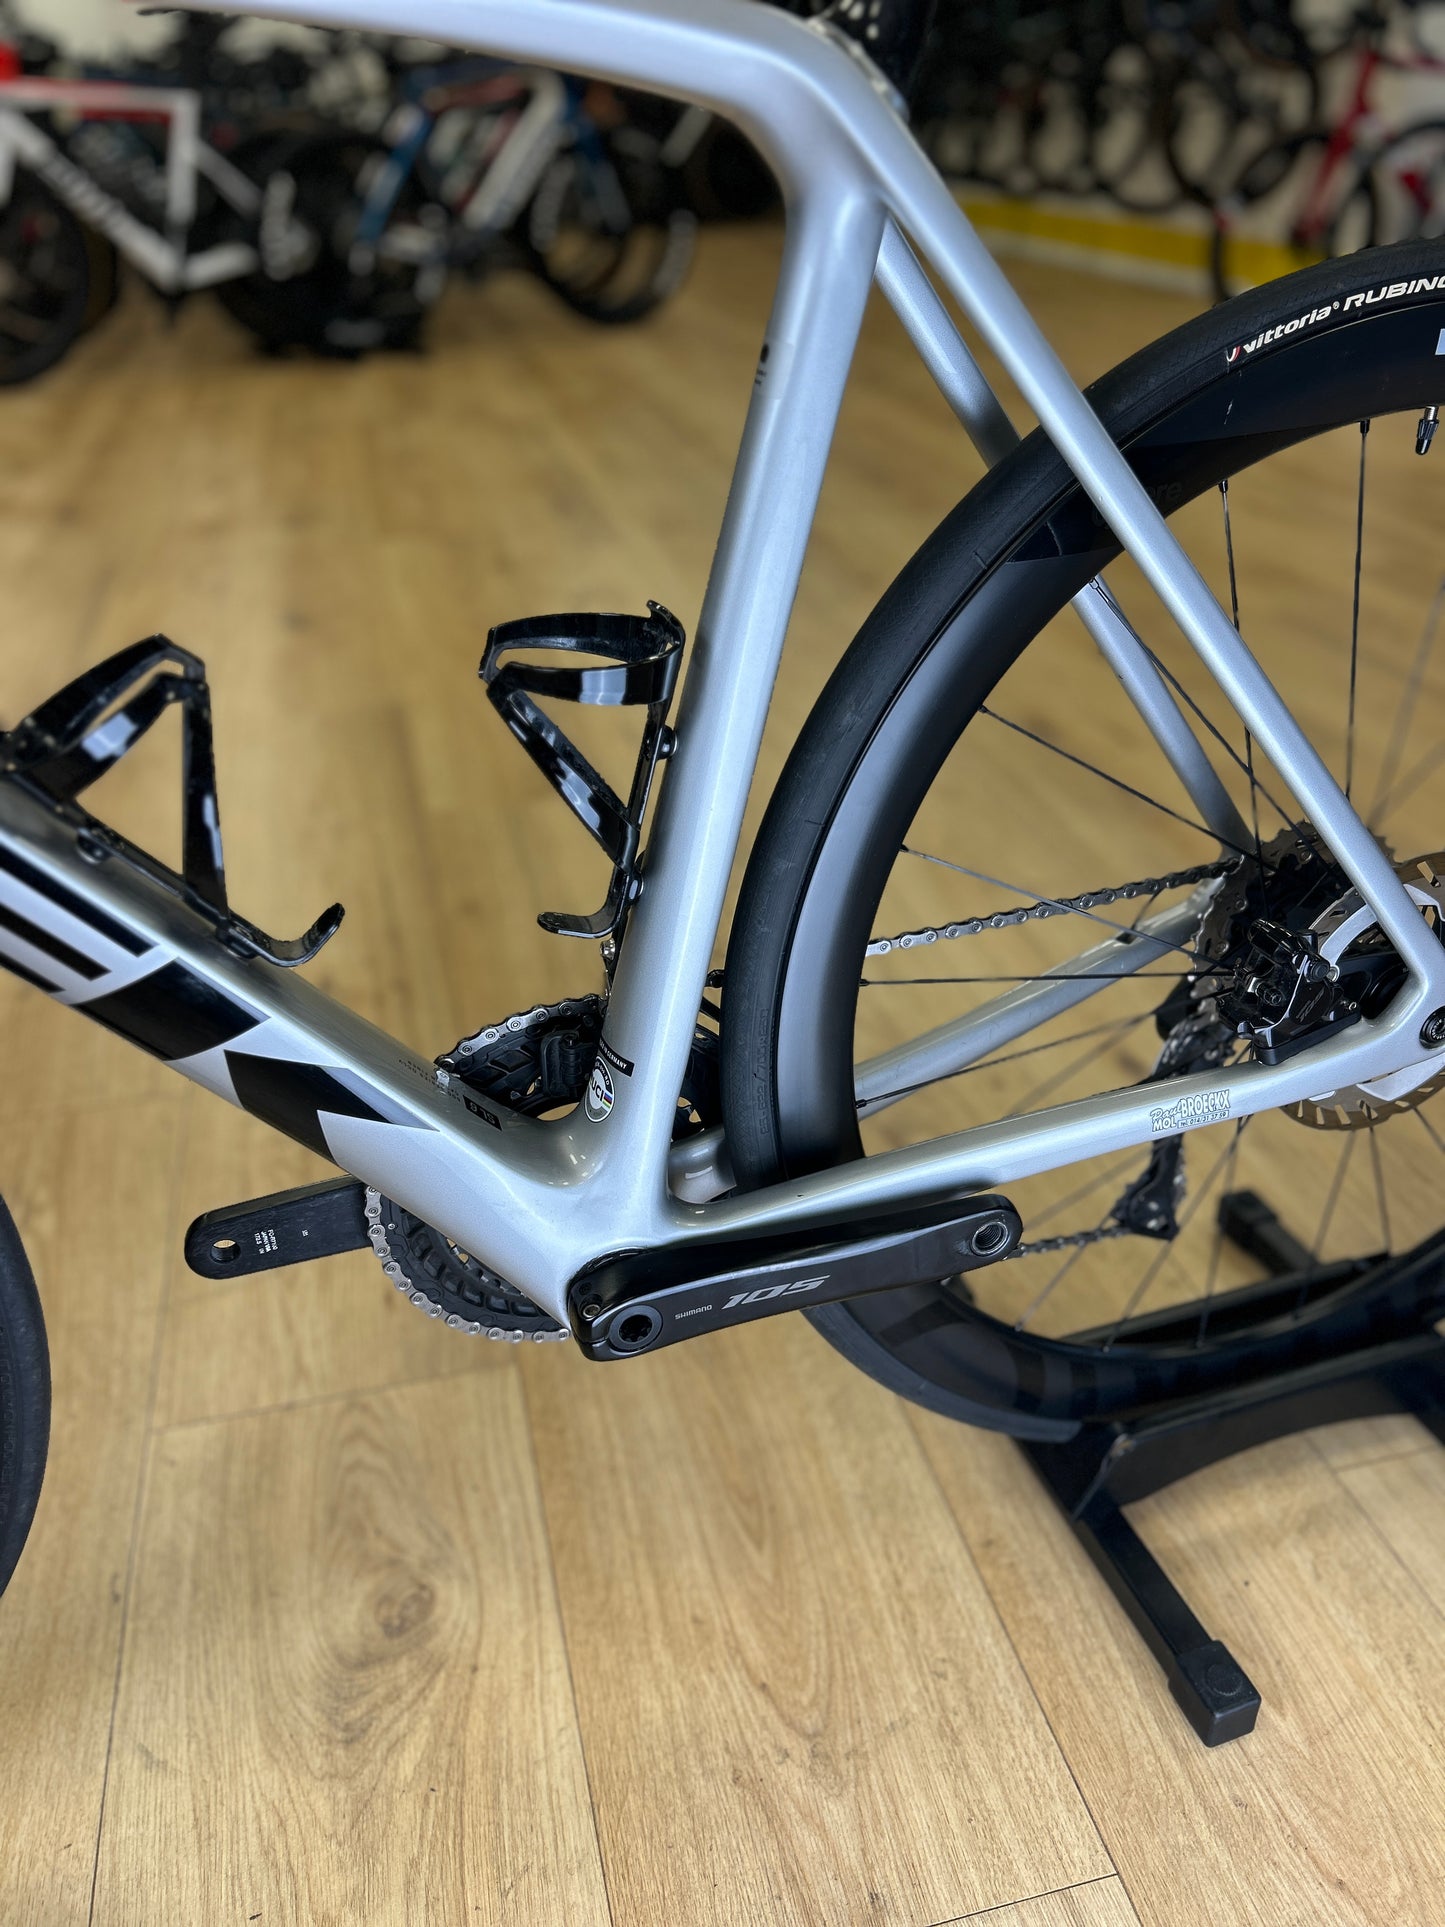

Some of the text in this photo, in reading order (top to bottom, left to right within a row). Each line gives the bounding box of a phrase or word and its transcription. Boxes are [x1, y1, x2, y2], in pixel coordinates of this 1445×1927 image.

[606, 1050, 628, 1070] GERMANY
[1179, 1088, 1231, 1118] BROECKX
[1152, 1115, 1177, 1132] MOL
[674, 1274, 831, 1320] SHIMANO 105
